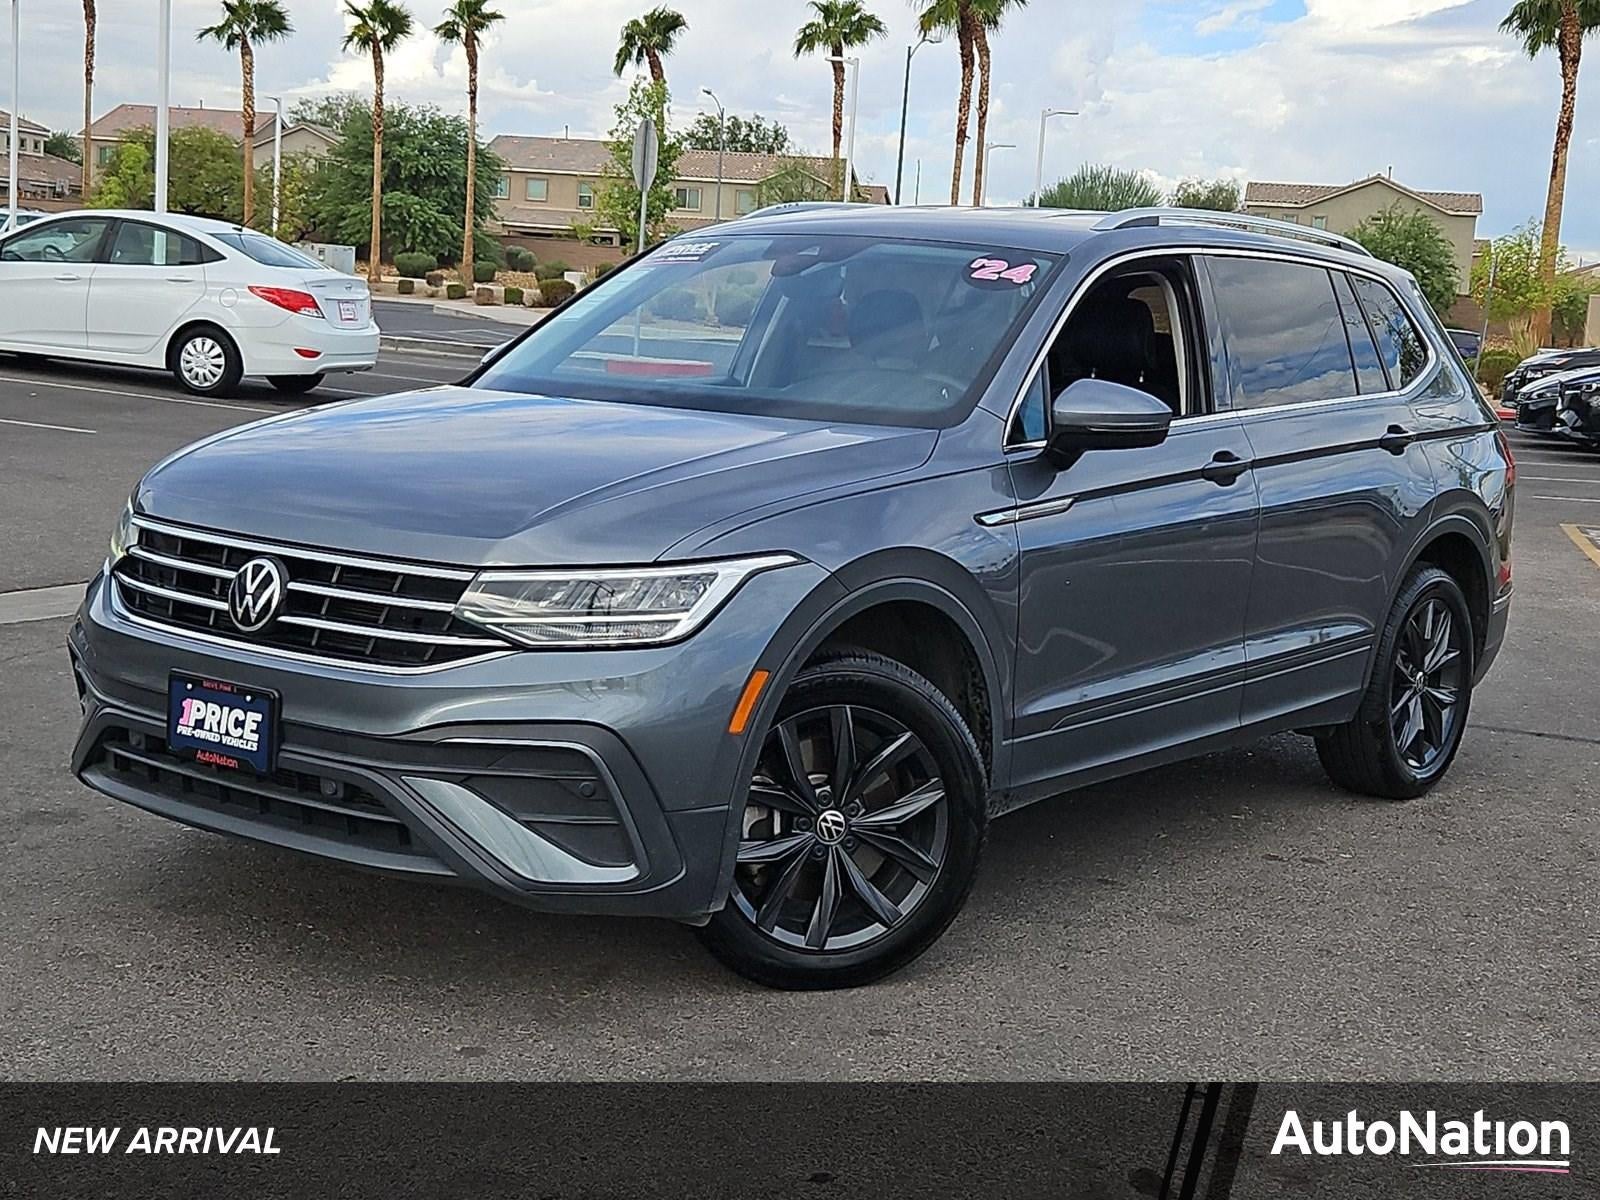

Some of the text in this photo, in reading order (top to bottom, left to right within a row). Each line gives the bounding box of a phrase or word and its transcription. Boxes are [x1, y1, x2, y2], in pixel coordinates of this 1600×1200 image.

[179, 698, 262, 741] 1PRICE
[176, 725, 259, 752] PRE-OWNED VEHICLES
[196, 750, 239, 769] AutoNation
